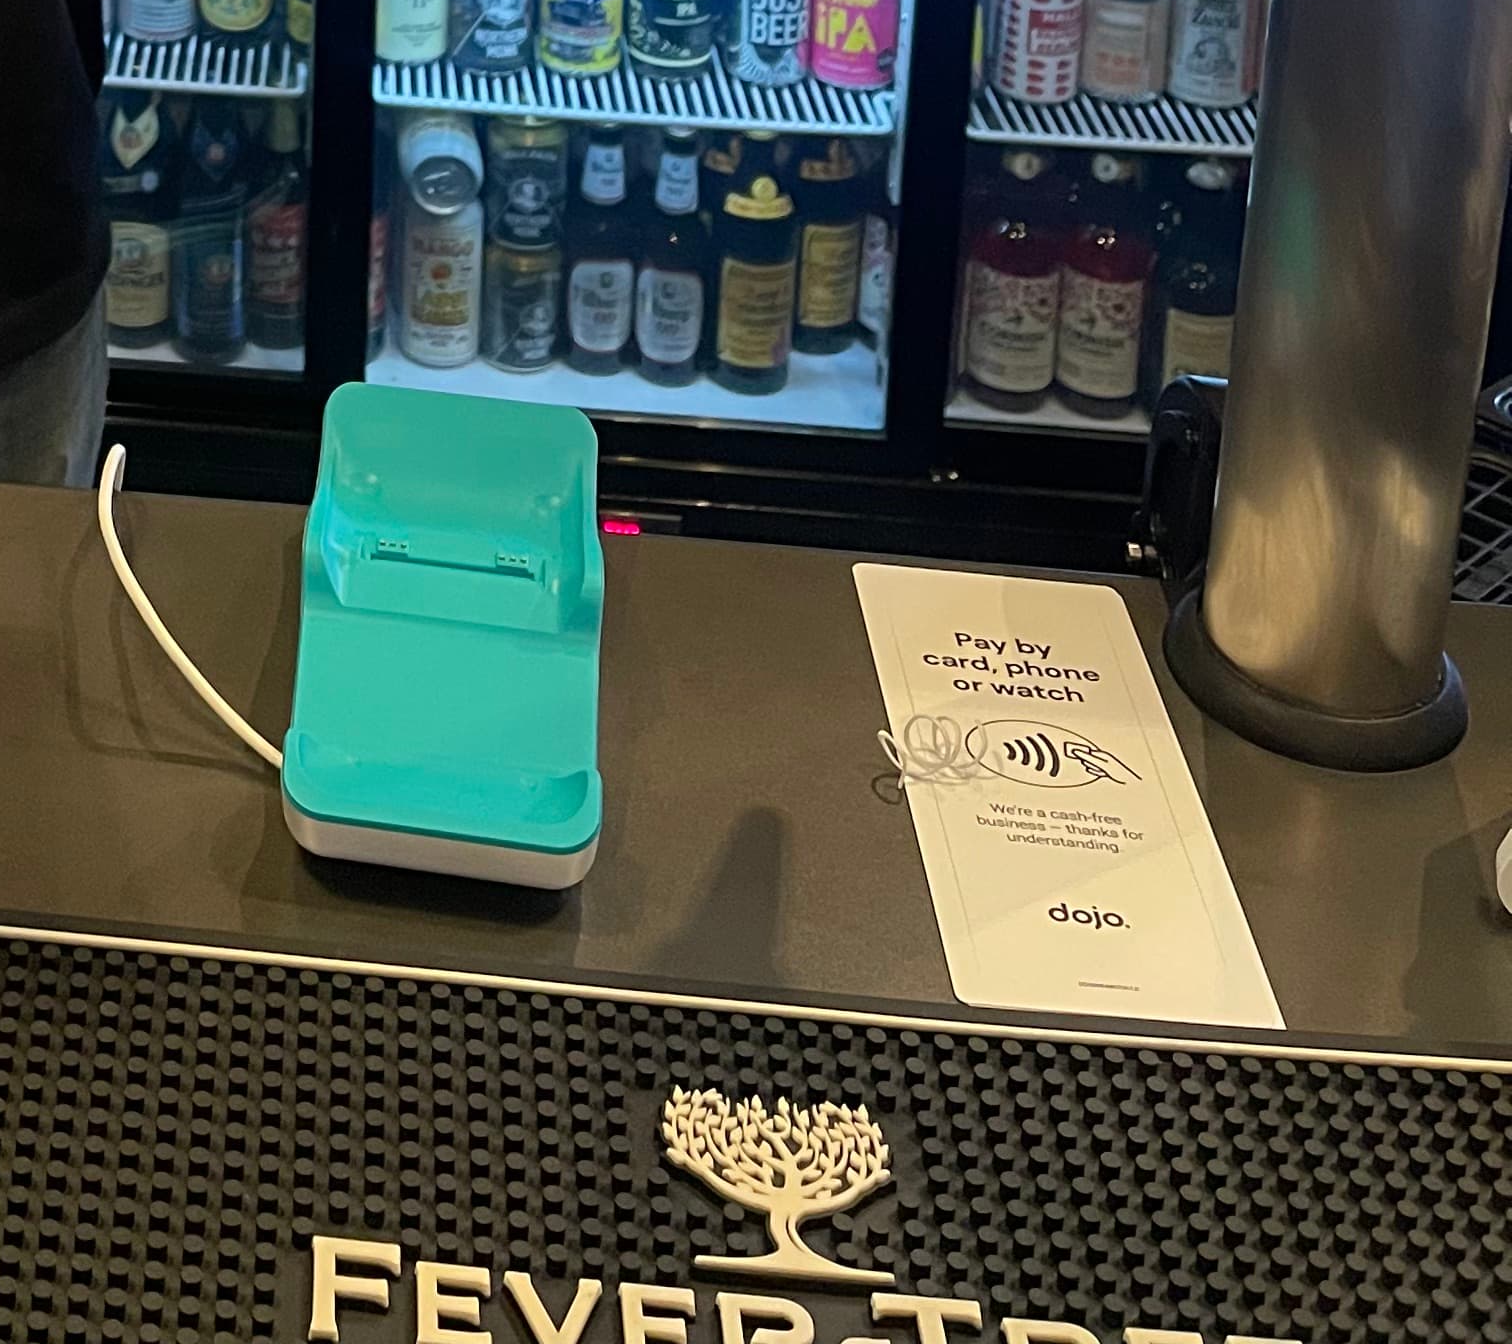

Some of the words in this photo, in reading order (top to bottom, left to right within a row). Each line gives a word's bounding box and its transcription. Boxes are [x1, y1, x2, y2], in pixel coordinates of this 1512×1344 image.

[751, 14, 808, 46] BEER
[953, 631, 1006, 657] Pay
[1015, 638, 1052, 660] by
[922, 652, 998, 675] card,
[1006, 661, 1101, 683] phone
[953, 678, 983, 692] or
[990, 680, 1085, 703] watch
[976, 814, 1046, 831] business
[1065, 823, 1119, 838] thanks
[1123, 828, 1144, 840] for
[990, 803, 1032, 817] We're
[1037, 808, 1047, 818] a
[1051, 809, 1123, 825] cash-free
[1048, 902, 1132, 930] dojo.
